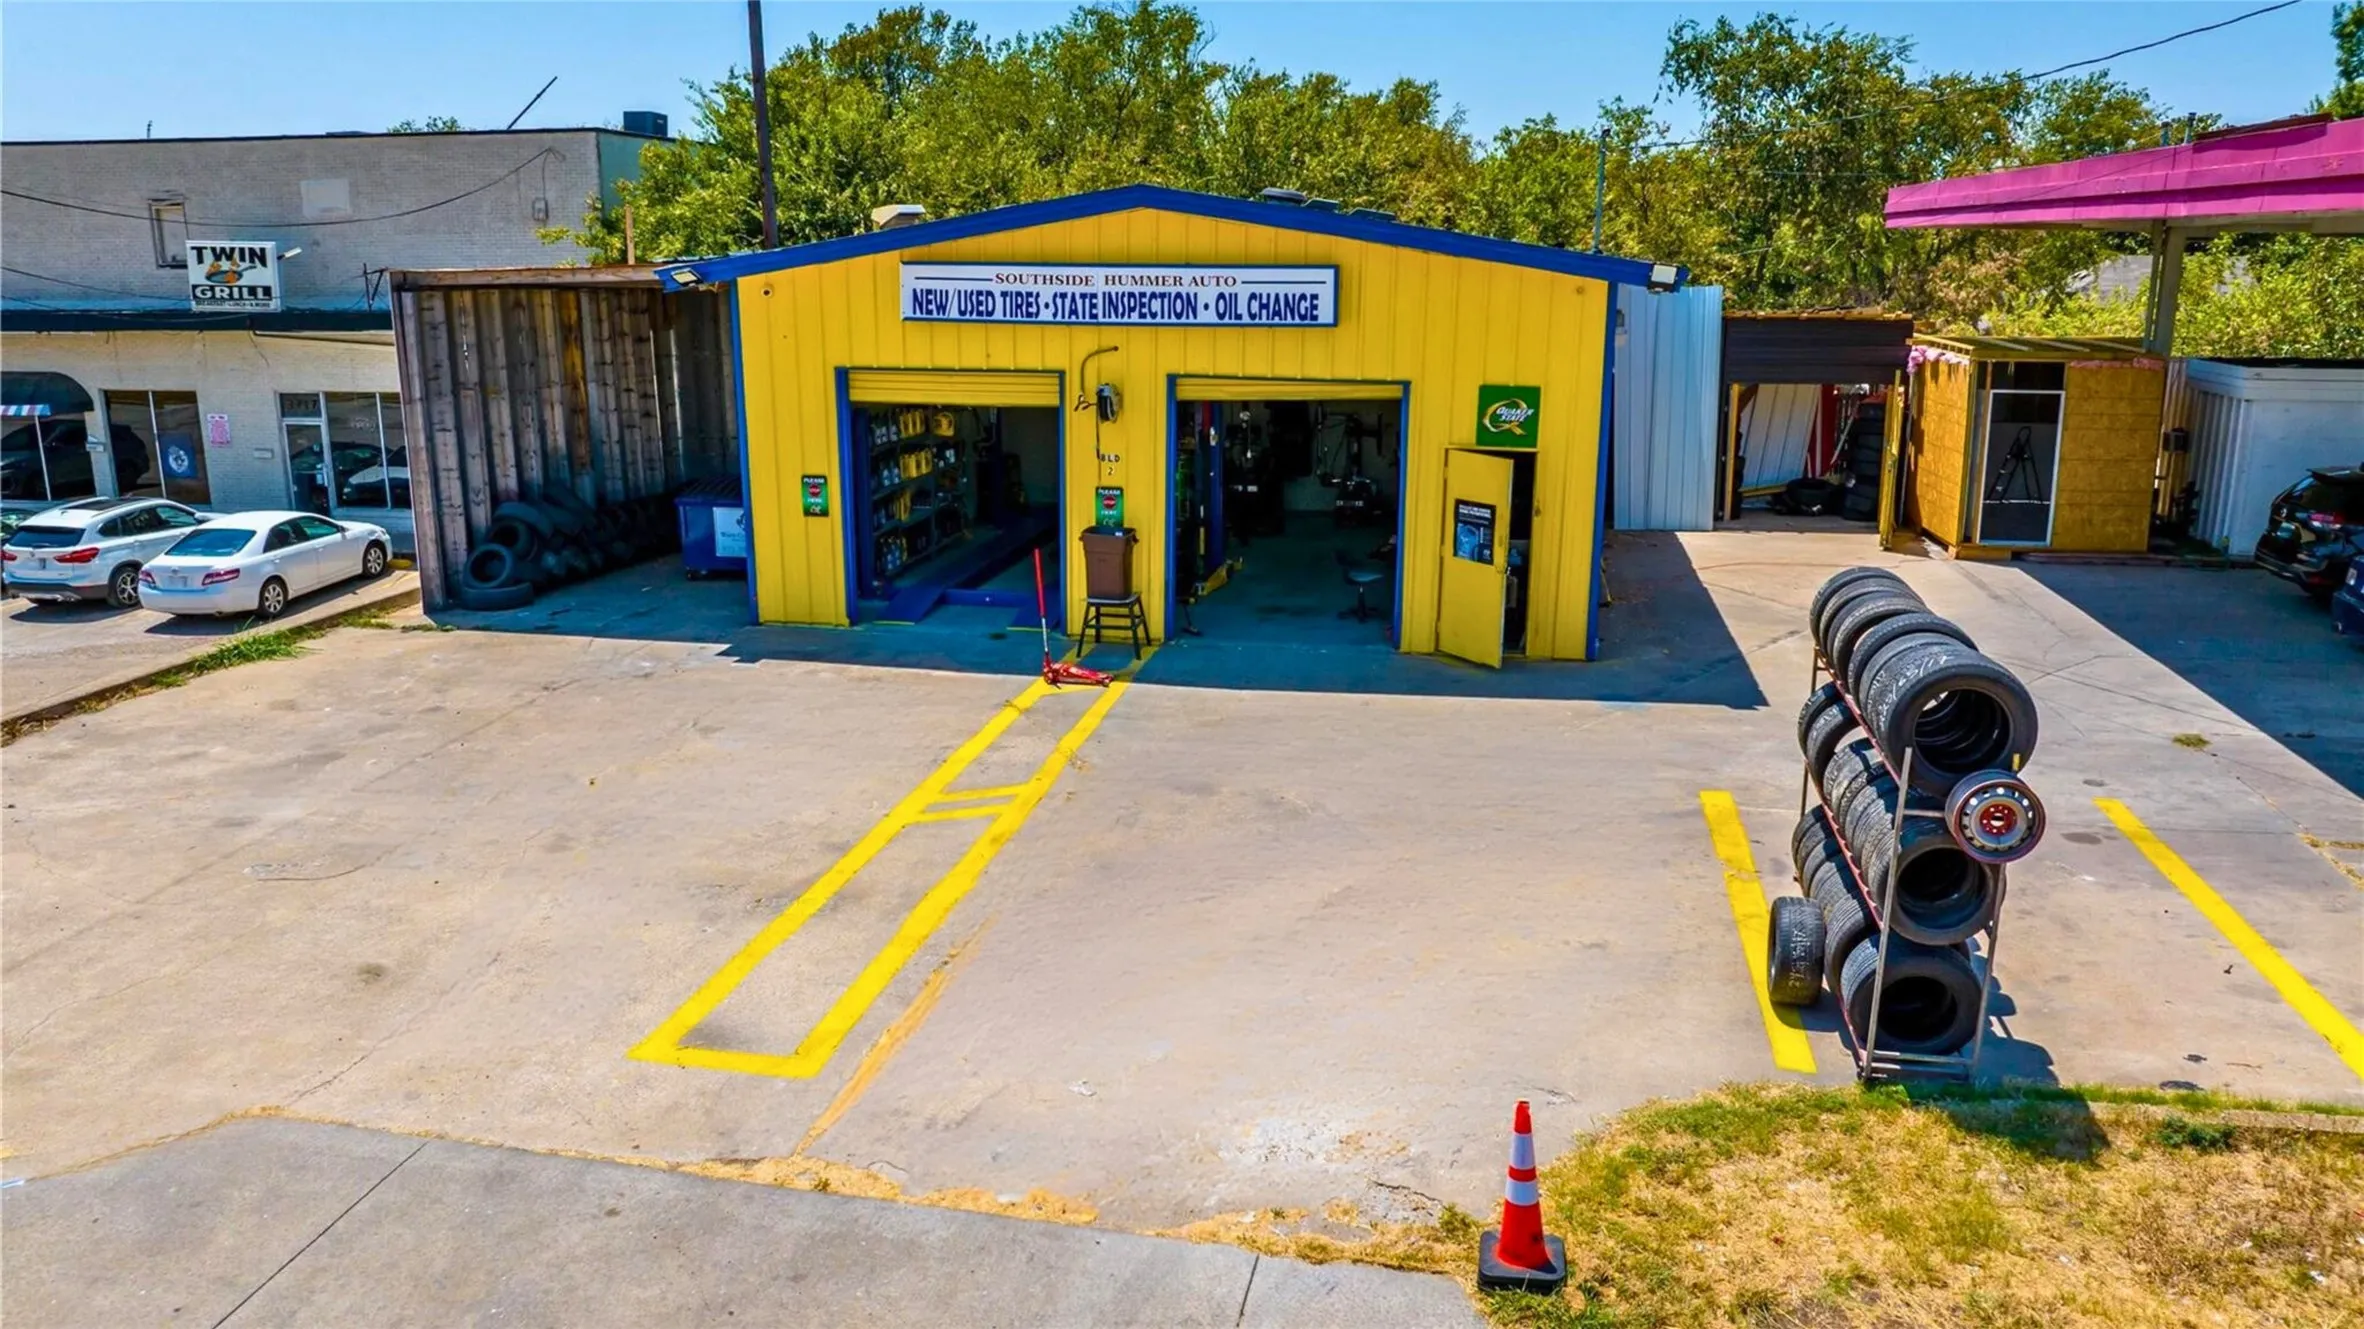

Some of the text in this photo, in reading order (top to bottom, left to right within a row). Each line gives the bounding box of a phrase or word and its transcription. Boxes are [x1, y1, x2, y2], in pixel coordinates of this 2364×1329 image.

[190, 246, 267, 268] TWIN
[995, 272, 1237, 287] SOUTHSIDE HUMMER AUTO
[194, 286, 271, 299] GRILL
[912, 288, 1319, 322] NEW/USED TIRES STATE INSPECTION OIL CHANGE
[1496, 406, 1534, 416] QUAKER
[1499, 414, 1525, 422] STATE
[1100, 454, 1120, 462] BLD
[1107, 466, 1114, 476] 2
